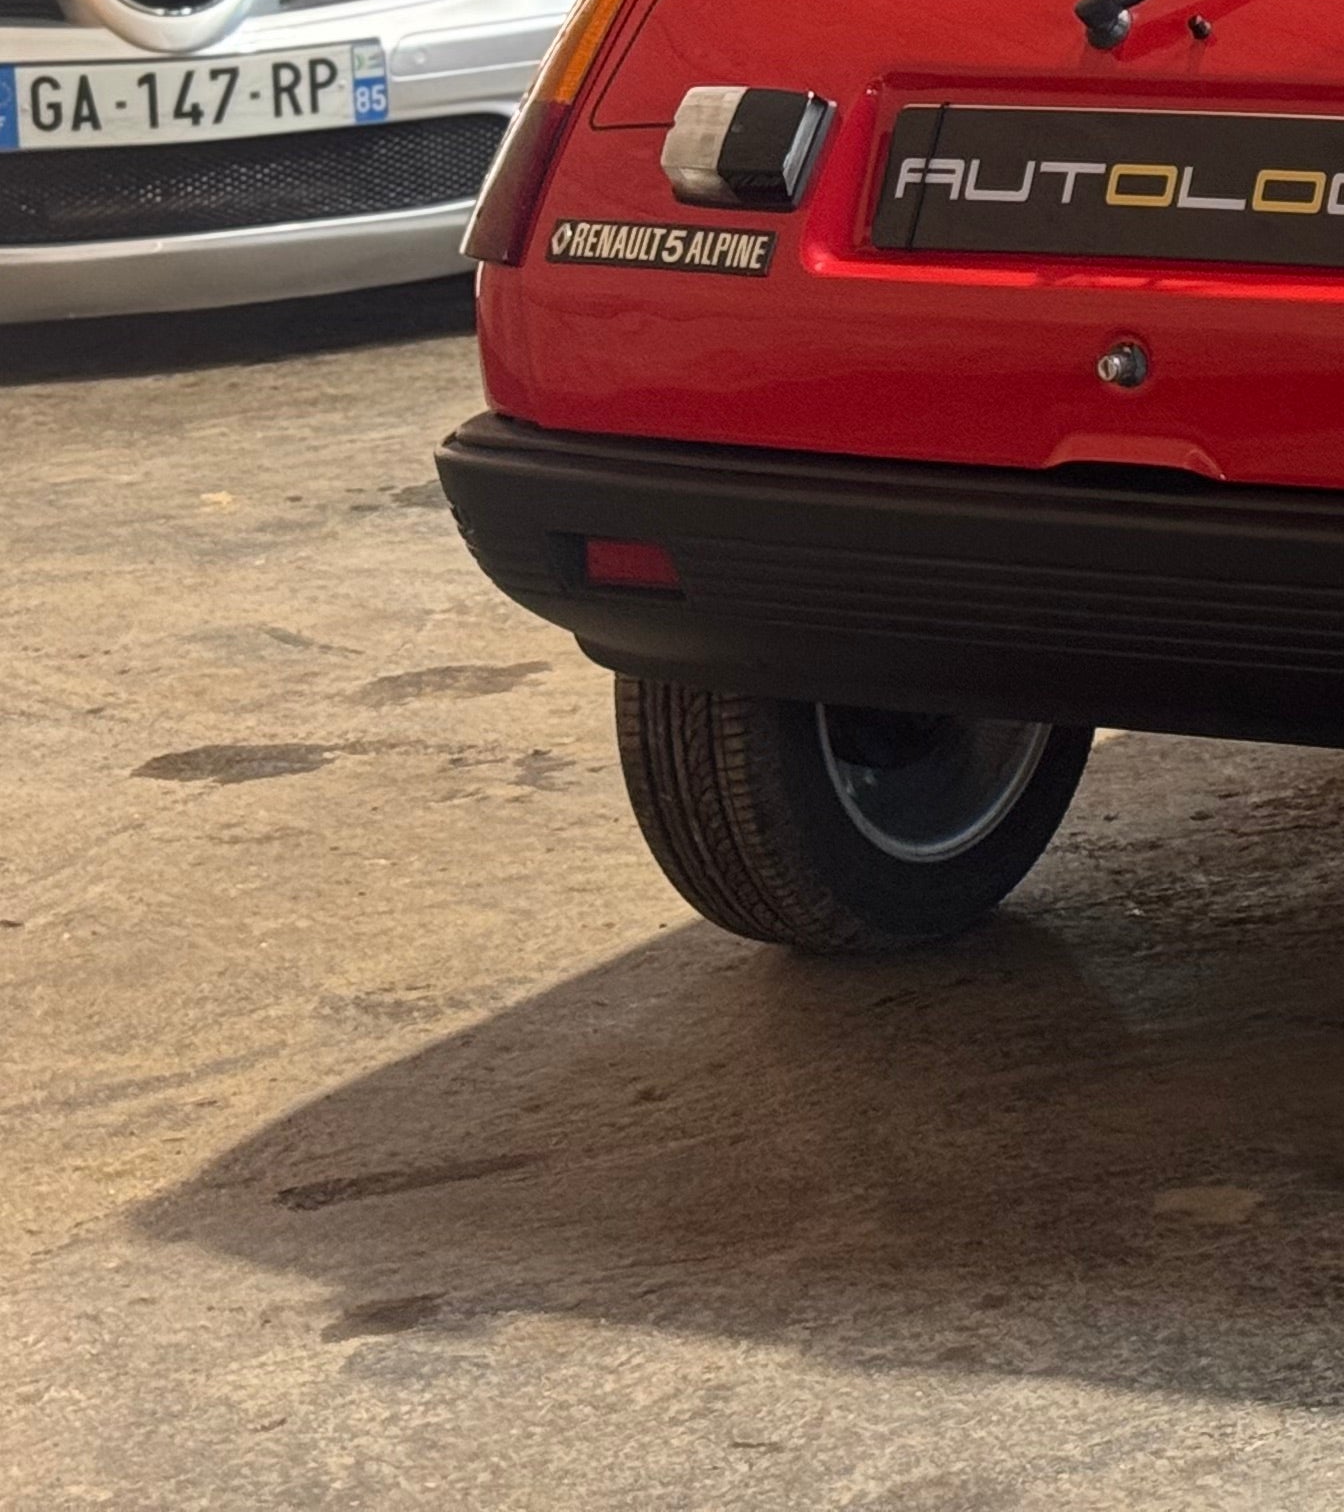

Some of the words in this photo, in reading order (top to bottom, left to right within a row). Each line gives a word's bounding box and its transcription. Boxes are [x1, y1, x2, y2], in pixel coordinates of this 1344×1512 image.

[30, 57, 338, 131] GA-147-RP
[356, 84, 387, 113] 85
[569, 222, 666, 262] RENAULT
[661, 229, 687, 263] 5
[685, 231, 769, 270] ALPINE
